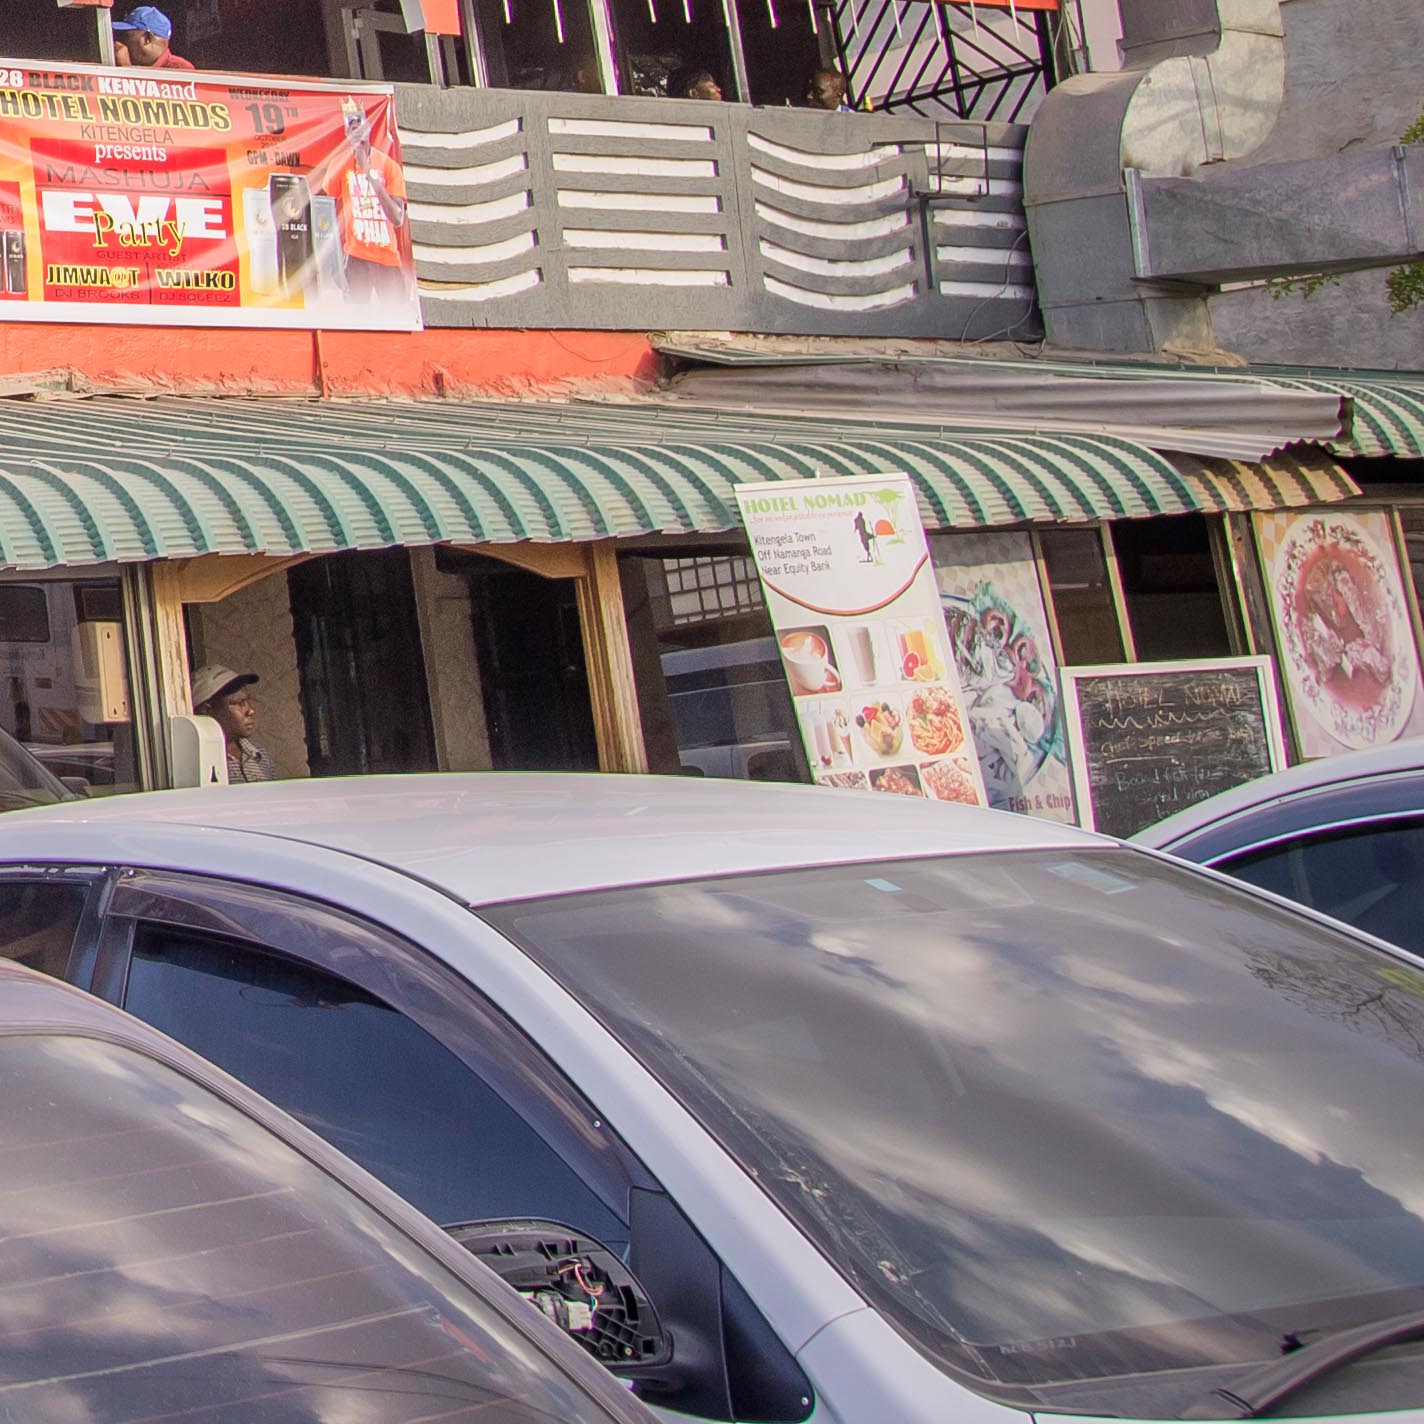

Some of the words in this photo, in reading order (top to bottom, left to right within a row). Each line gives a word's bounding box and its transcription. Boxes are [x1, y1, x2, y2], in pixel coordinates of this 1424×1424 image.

[28, 72, 94, 91] BLACK
[98, 76, 160, 97] KENYA
[161, 81, 197, 100] and
[97, 94, 232, 131] NOMADS
[80, 124, 174, 144] KITENGELA
[94, 143, 167, 163] presents
[276, 152, 301, 167] DAWN
[46, 163, 210, 191] MASHUJA
[41, 191, 227, 240] EVE
[92, 211, 188, 256] Party
[96, 250, 140, 261] GUEST
[144, 252, 187, 263] ARTIST
[155, 268, 235, 290] WILKO
[55, 289, 72, 299] DJ
[76, 289, 140, 301] BROOKS
[159, 292, 175, 302] DJ
[743, 496, 798, 513] HOTEL
[803, 492, 867, 509] NOMAD
[754, 533, 793, 546] Kitengela
[795, 532, 816, 542] Town
[757, 550, 773, 561] Off
[774, 548, 811, 560] Namanga
[812, 545, 832, 556] Road
[762, 565, 781, 576] Near
[783, 563, 809, 575] Equity
[811, 561, 831, 572] Bank
[1008, 795, 1032, 811] Fish
[1034, 794, 1044, 809] &
